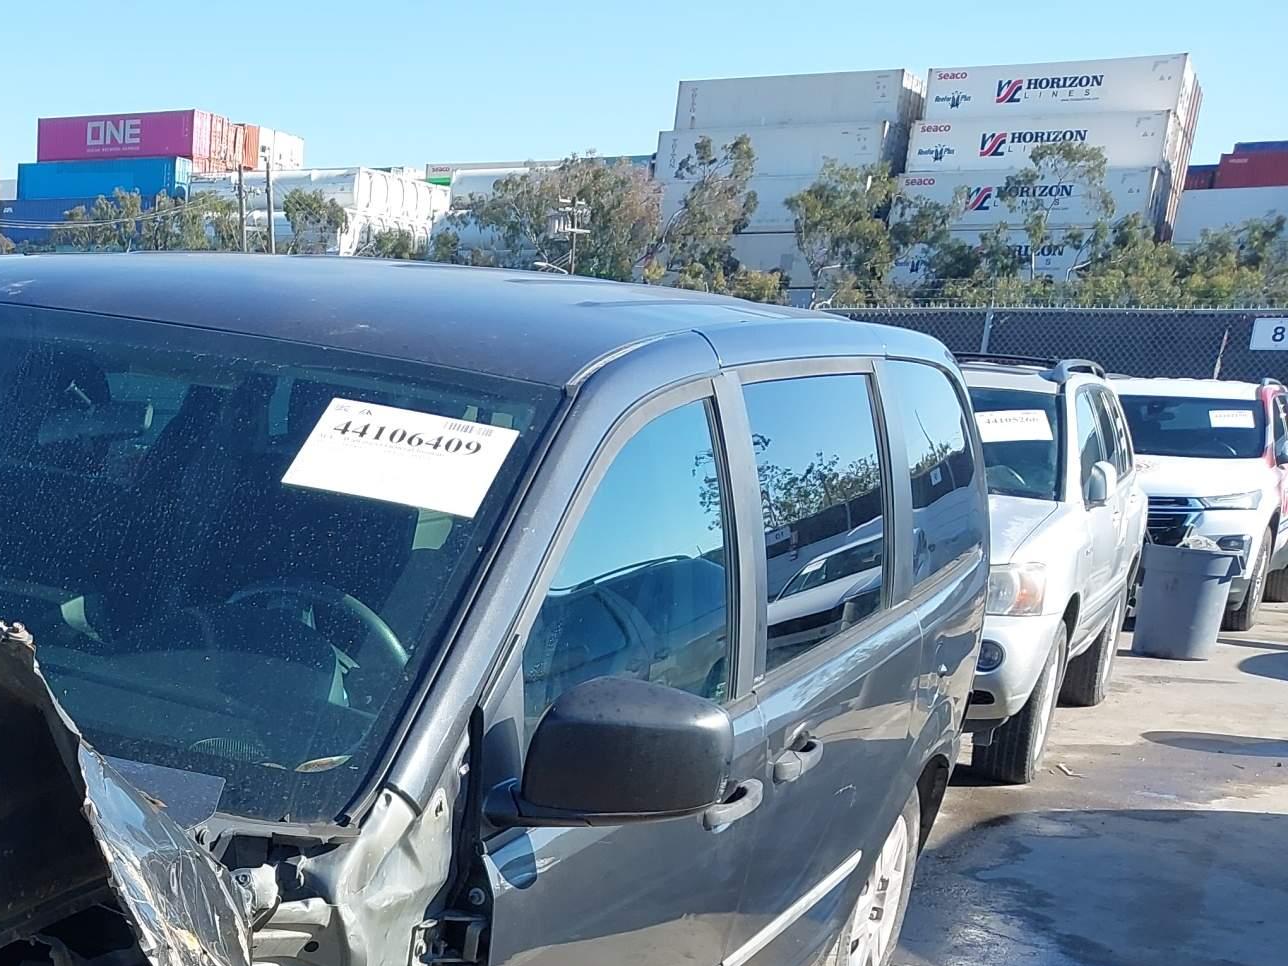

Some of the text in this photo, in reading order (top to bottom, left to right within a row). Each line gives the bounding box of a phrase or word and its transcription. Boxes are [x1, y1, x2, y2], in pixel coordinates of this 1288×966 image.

[937, 71, 968, 81] seaco
[1026, 74, 1104, 90] HORIZON
[1023, 89, 1090, 98] LINES
[86, 119, 141, 146] ONE
[920, 123, 952, 133] seaco
[1010, 129, 1088, 144] HORIZON
[904, 177, 936, 187] seaco
[332, 419, 483, 456] 44106409
